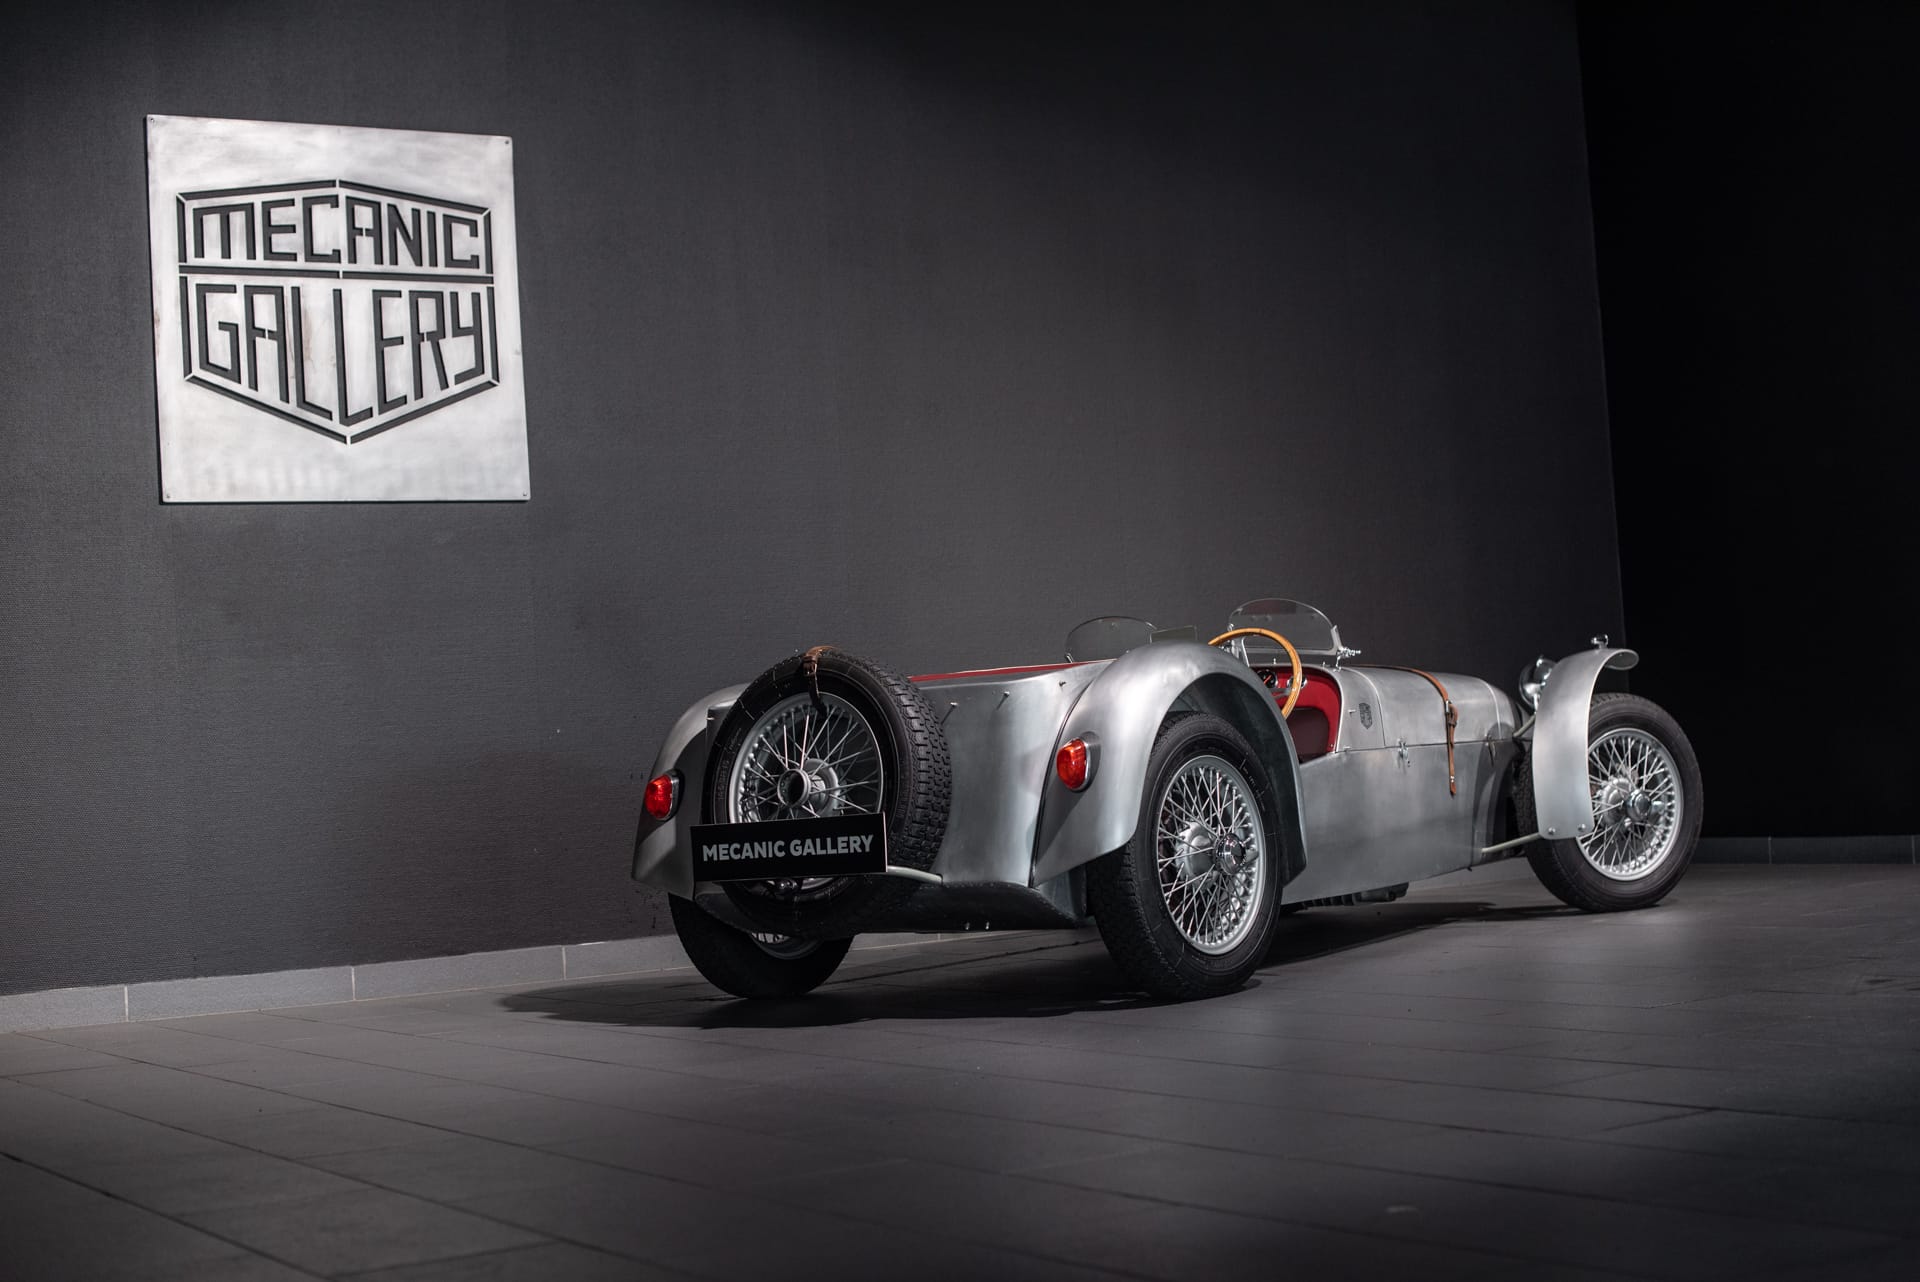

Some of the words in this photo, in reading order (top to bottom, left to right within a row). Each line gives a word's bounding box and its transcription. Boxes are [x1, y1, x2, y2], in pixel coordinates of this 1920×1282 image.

[193, 194, 480, 268] MECANIC
[195, 283, 486, 427] GALLERY
[702, 840, 785, 862] MECANIC
[789, 834, 873, 857] GALLERY
